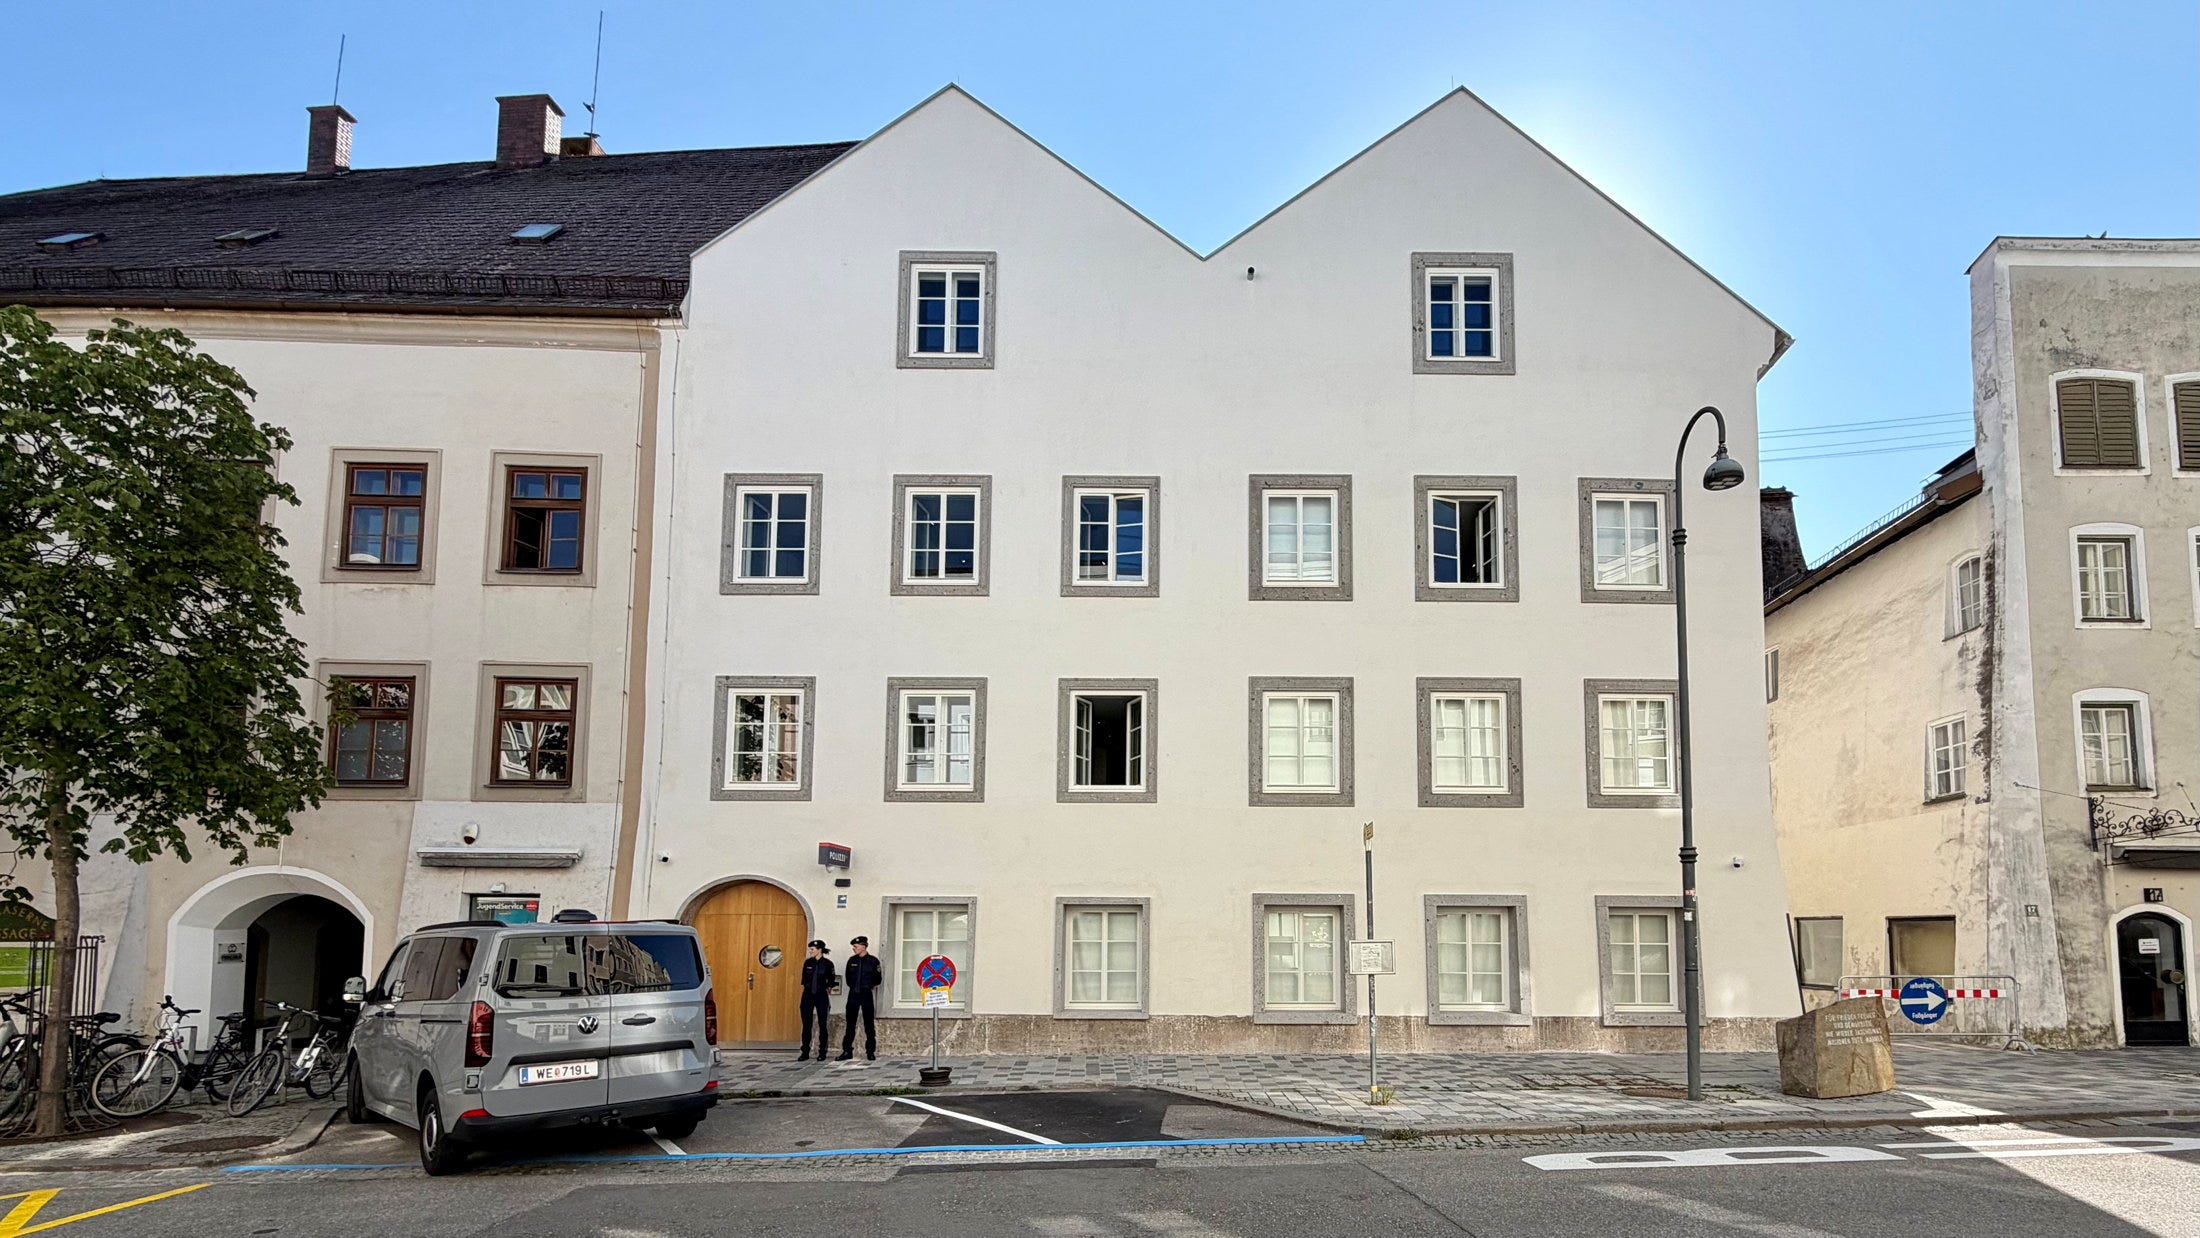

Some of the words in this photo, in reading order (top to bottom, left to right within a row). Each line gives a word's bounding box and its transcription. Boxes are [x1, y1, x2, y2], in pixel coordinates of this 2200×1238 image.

[476, 903, 523, 911] JugendService
[0, 906, 49, 930] ASERNE
[1912, 1012, 1938, 1020] Fußgänger
[536, 1067, 553, 1079] WE
